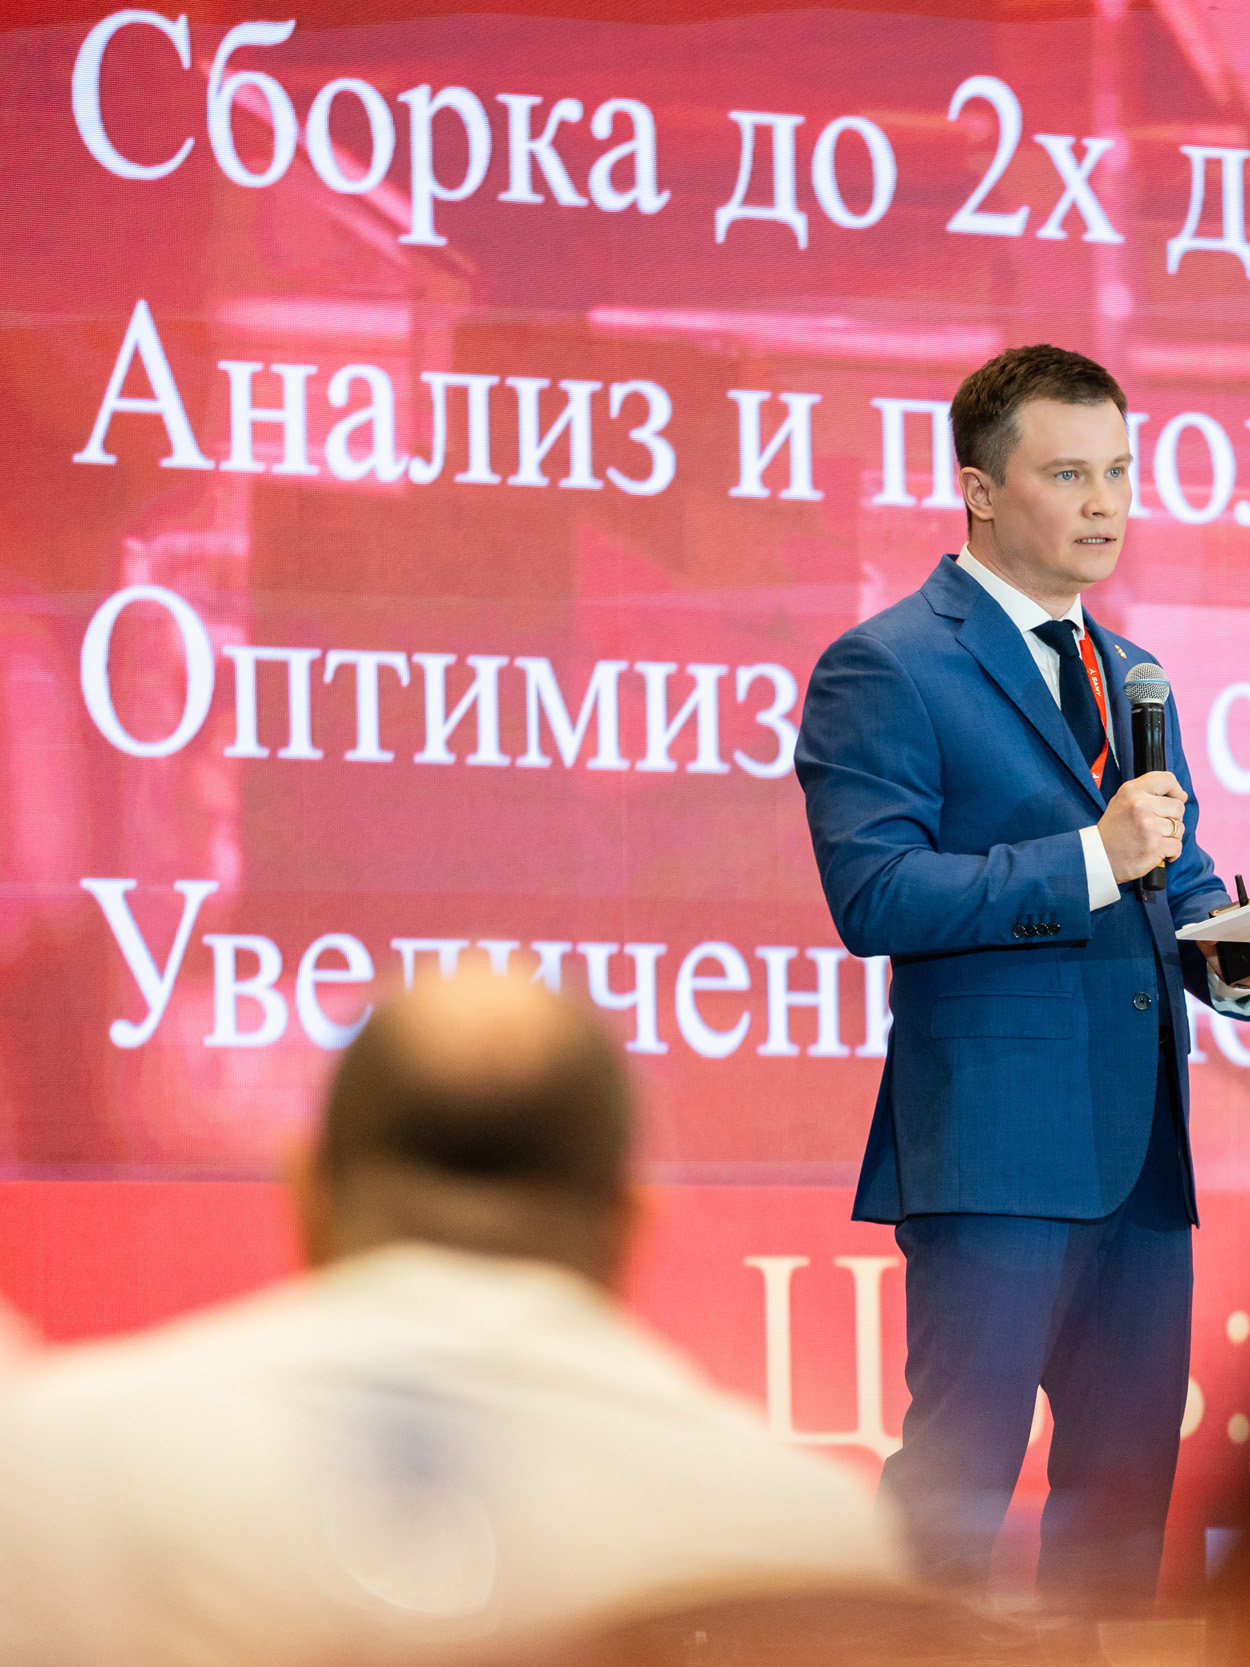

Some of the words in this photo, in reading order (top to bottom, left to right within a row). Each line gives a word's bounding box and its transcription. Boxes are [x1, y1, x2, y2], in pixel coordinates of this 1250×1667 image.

[72, 9, 671, 246] Сборка
[715, 110, 898, 250] до
[945, 74, 1126, 244] 2х
[73, 299, 677, 497] Анализ
[727, 389, 824, 501] и
[80, 585, 800, 779] Оптимиз
